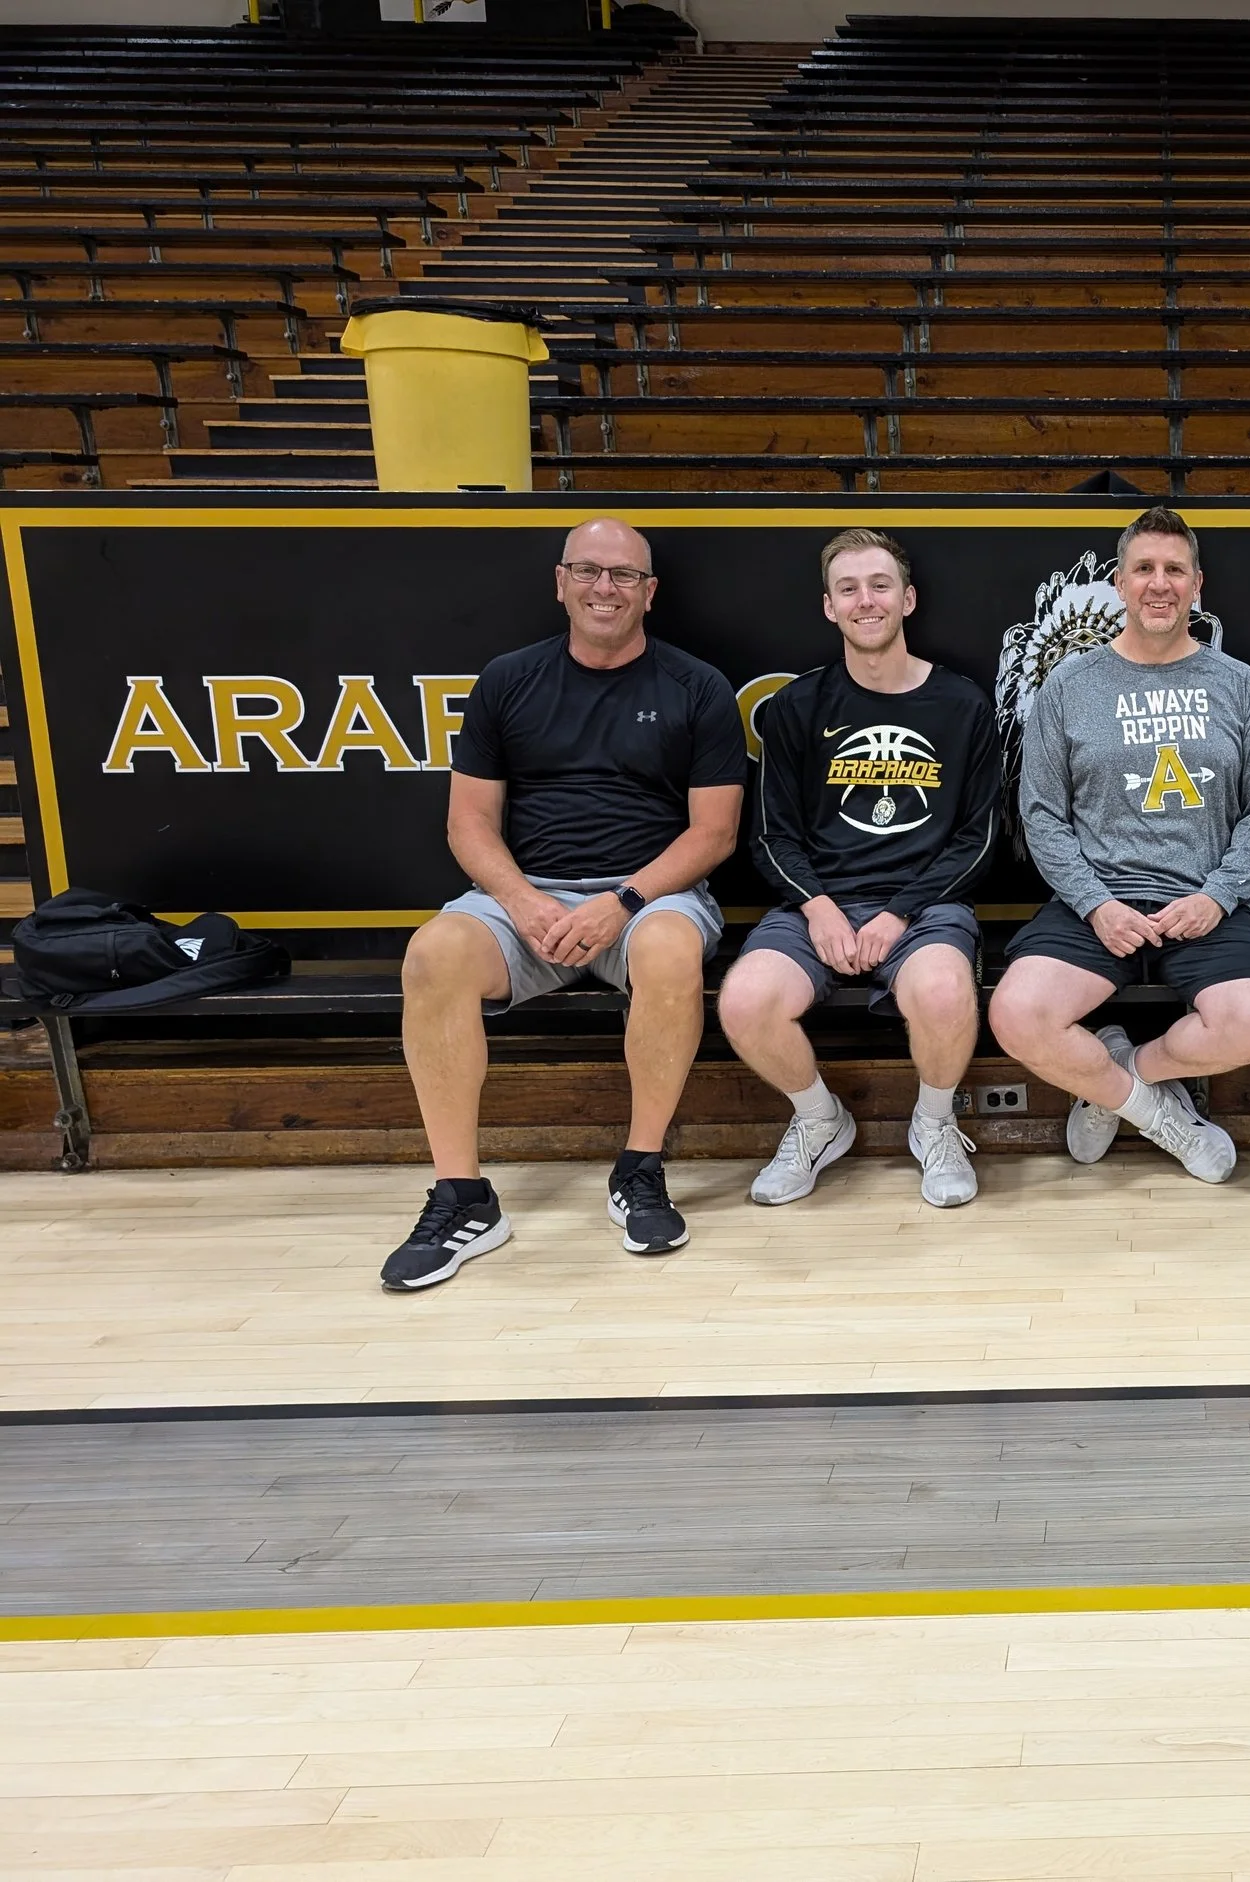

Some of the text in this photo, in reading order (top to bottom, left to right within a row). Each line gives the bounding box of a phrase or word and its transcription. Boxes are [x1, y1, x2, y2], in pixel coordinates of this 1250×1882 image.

[1116, 689, 1208, 718] ALWAYS
[1122, 715, 1210, 745] REPPIN'
[828, 759, 942, 780] ARAPAHOE
[1141, 743, 1204, 812] A
